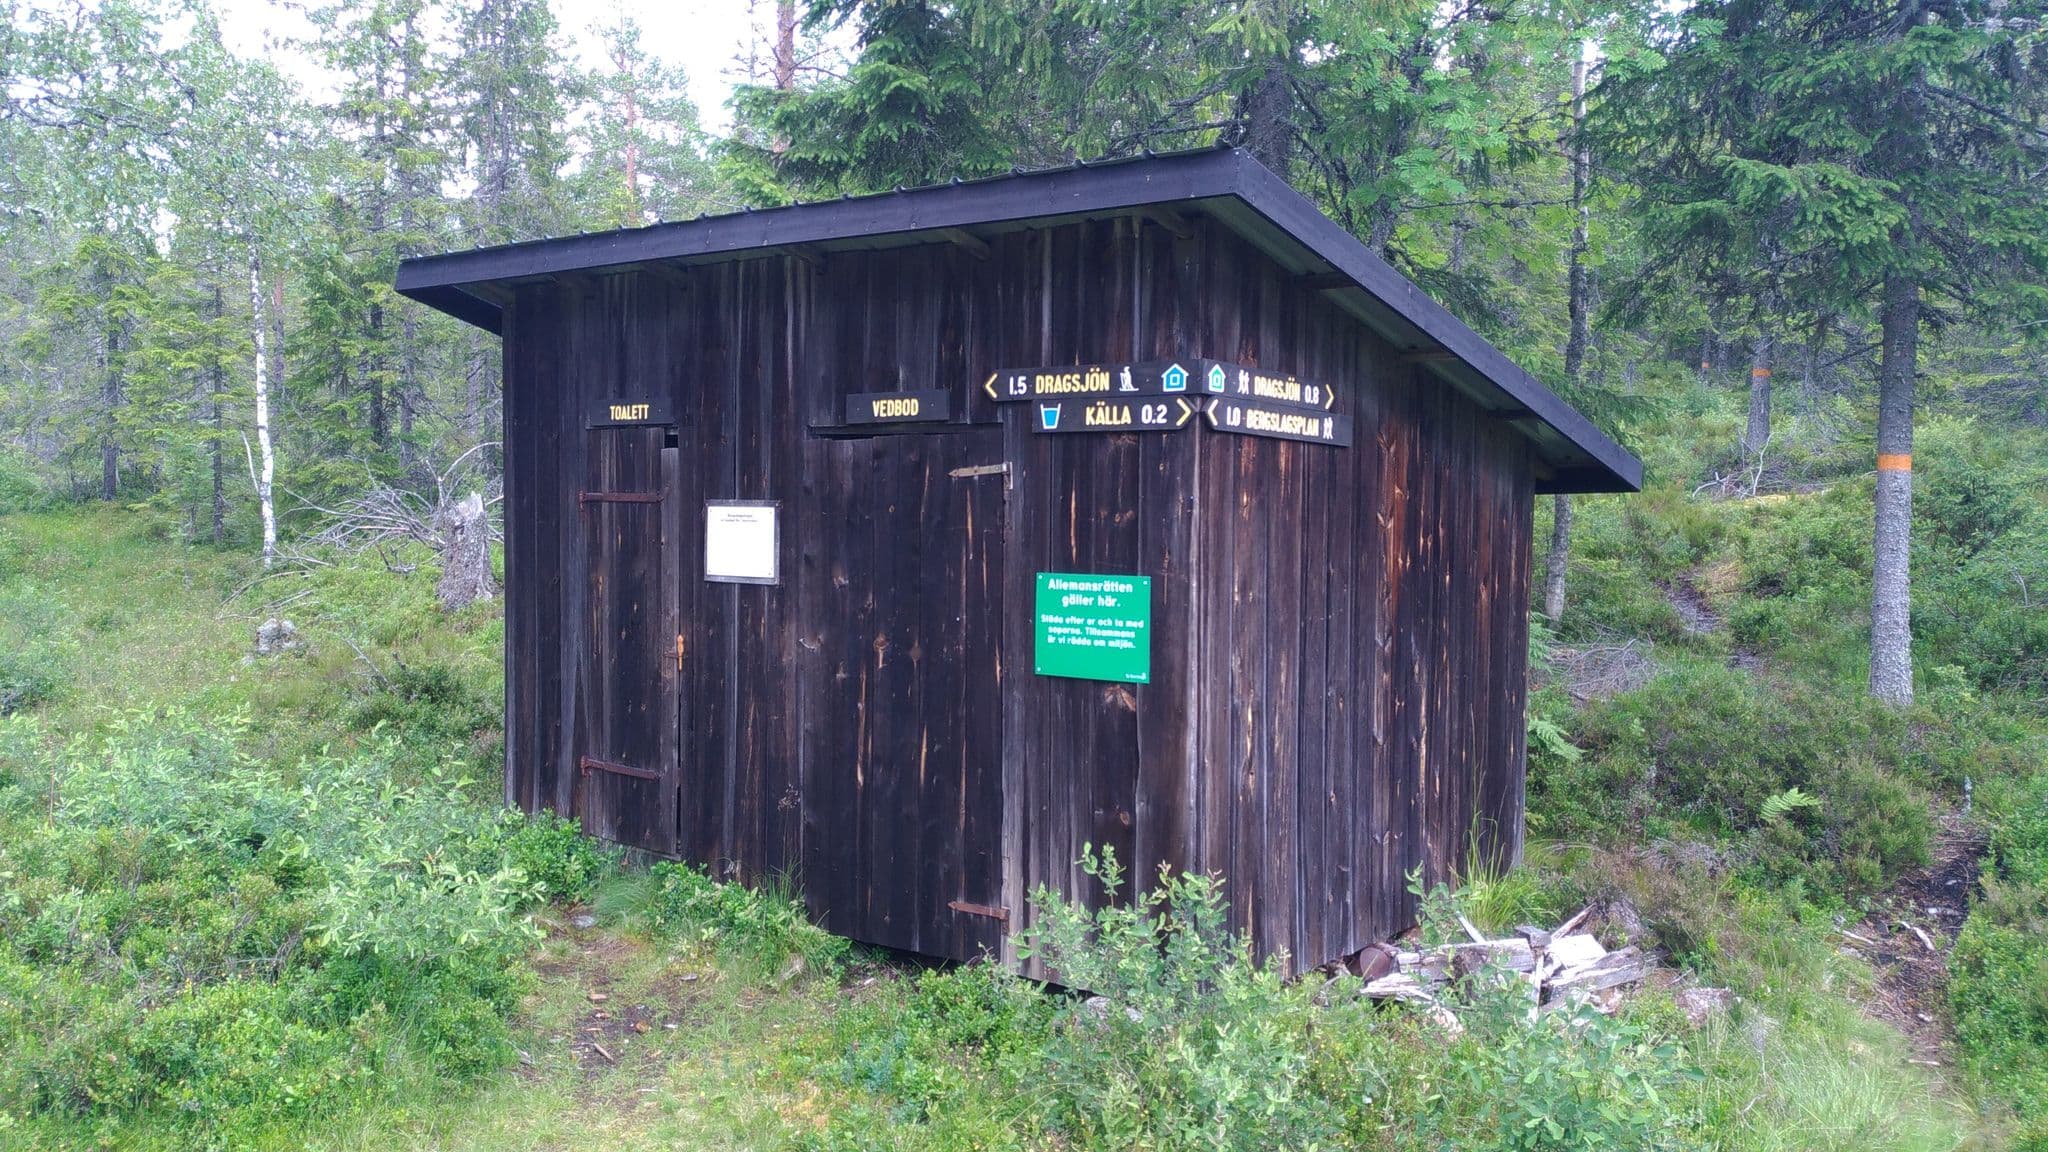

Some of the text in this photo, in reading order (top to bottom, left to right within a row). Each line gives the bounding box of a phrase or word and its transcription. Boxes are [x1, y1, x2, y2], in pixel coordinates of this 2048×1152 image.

[1009, 367, 1110, 395] 1.5 DRAGSJÖN
[1254, 376, 1320, 405] DRAGSJÖN 0.8
[609, 404, 649, 420] TOALETT
[872, 398, 919, 417] VEDBOD
[1085, 401, 1168, 426] KÄLLA 0.2
[1226, 406, 1241, 427] 1.0
[1048, 578, 1133, 592] Allemansrätten
[1062, 594, 1121, 607] gäller här.
[1041, 614, 1145, 629] Städa efter er och ta med
[1085, 627, 1136, 639] Tillsammans
[1058, 636, 1066, 644] vi
[1093, 639, 1106, 648] om
